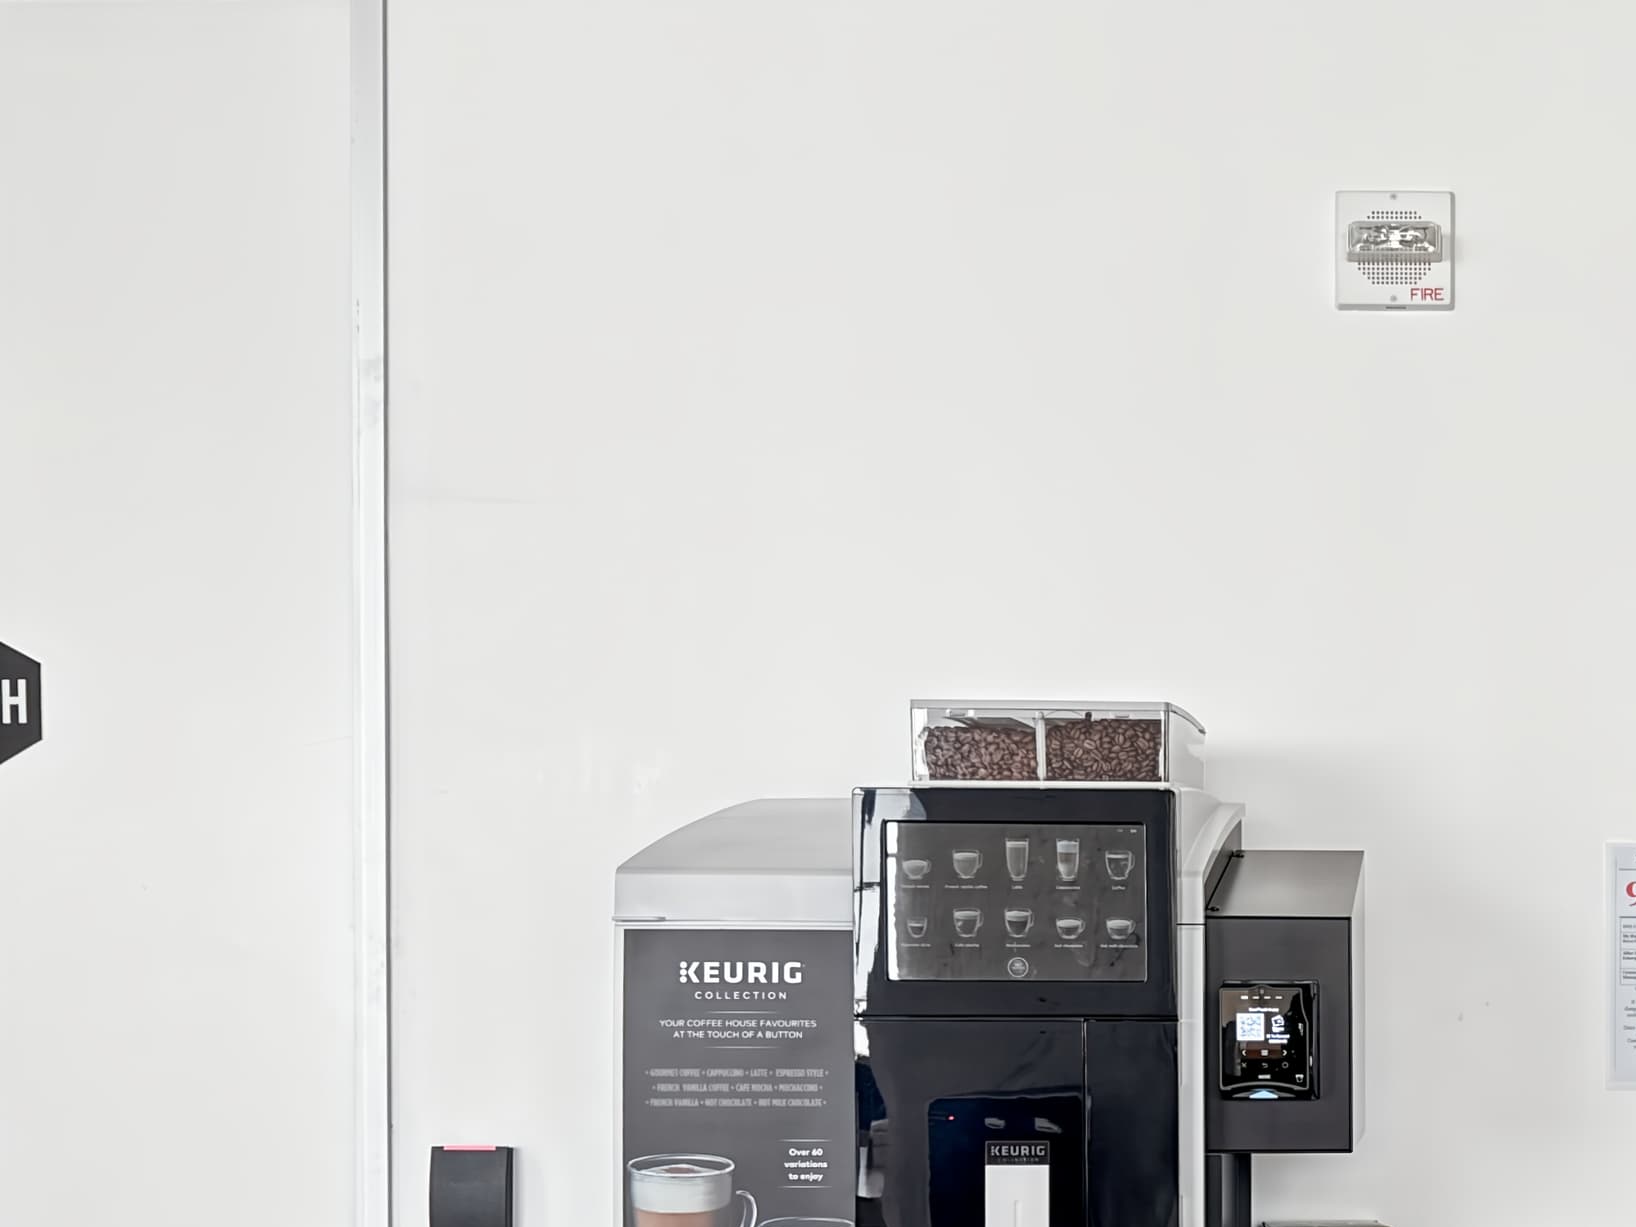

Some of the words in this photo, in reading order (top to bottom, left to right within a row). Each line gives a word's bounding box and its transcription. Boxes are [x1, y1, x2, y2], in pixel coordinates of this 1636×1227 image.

[1410, 287, 1445, 302] FIRE
[679, 961, 803, 984] KEURIG
[694, 991, 788, 1000] COLLECTION
[659, 1019, 686, 1028] YOUR
[686, 1019, 723, 1028] COFFEE
[725, 1019, 758, 1028] HOUSE
[760, 1019, 817, 1028] FAVOURITES
[673, 1030, 686, 1039] AT
[687, 1030, 705, 1039] THE
[707, 1030, 740, 1039] TOUCH
[741, 1030, 755, 1039] OF
[756, 1030, 764, 1039] A
[765, 1030, 803, 1039] BUTTON
[788, 1147, 811, 1157] Over
[811, 1147, 823, 1157] 60
[991, 1145, 1045, 1156] KEURIG
[783, 1159, 828, 1168] variations
[788, 1171, 799, 1182] to
[799, 1171, 824, 1182] enjoy
